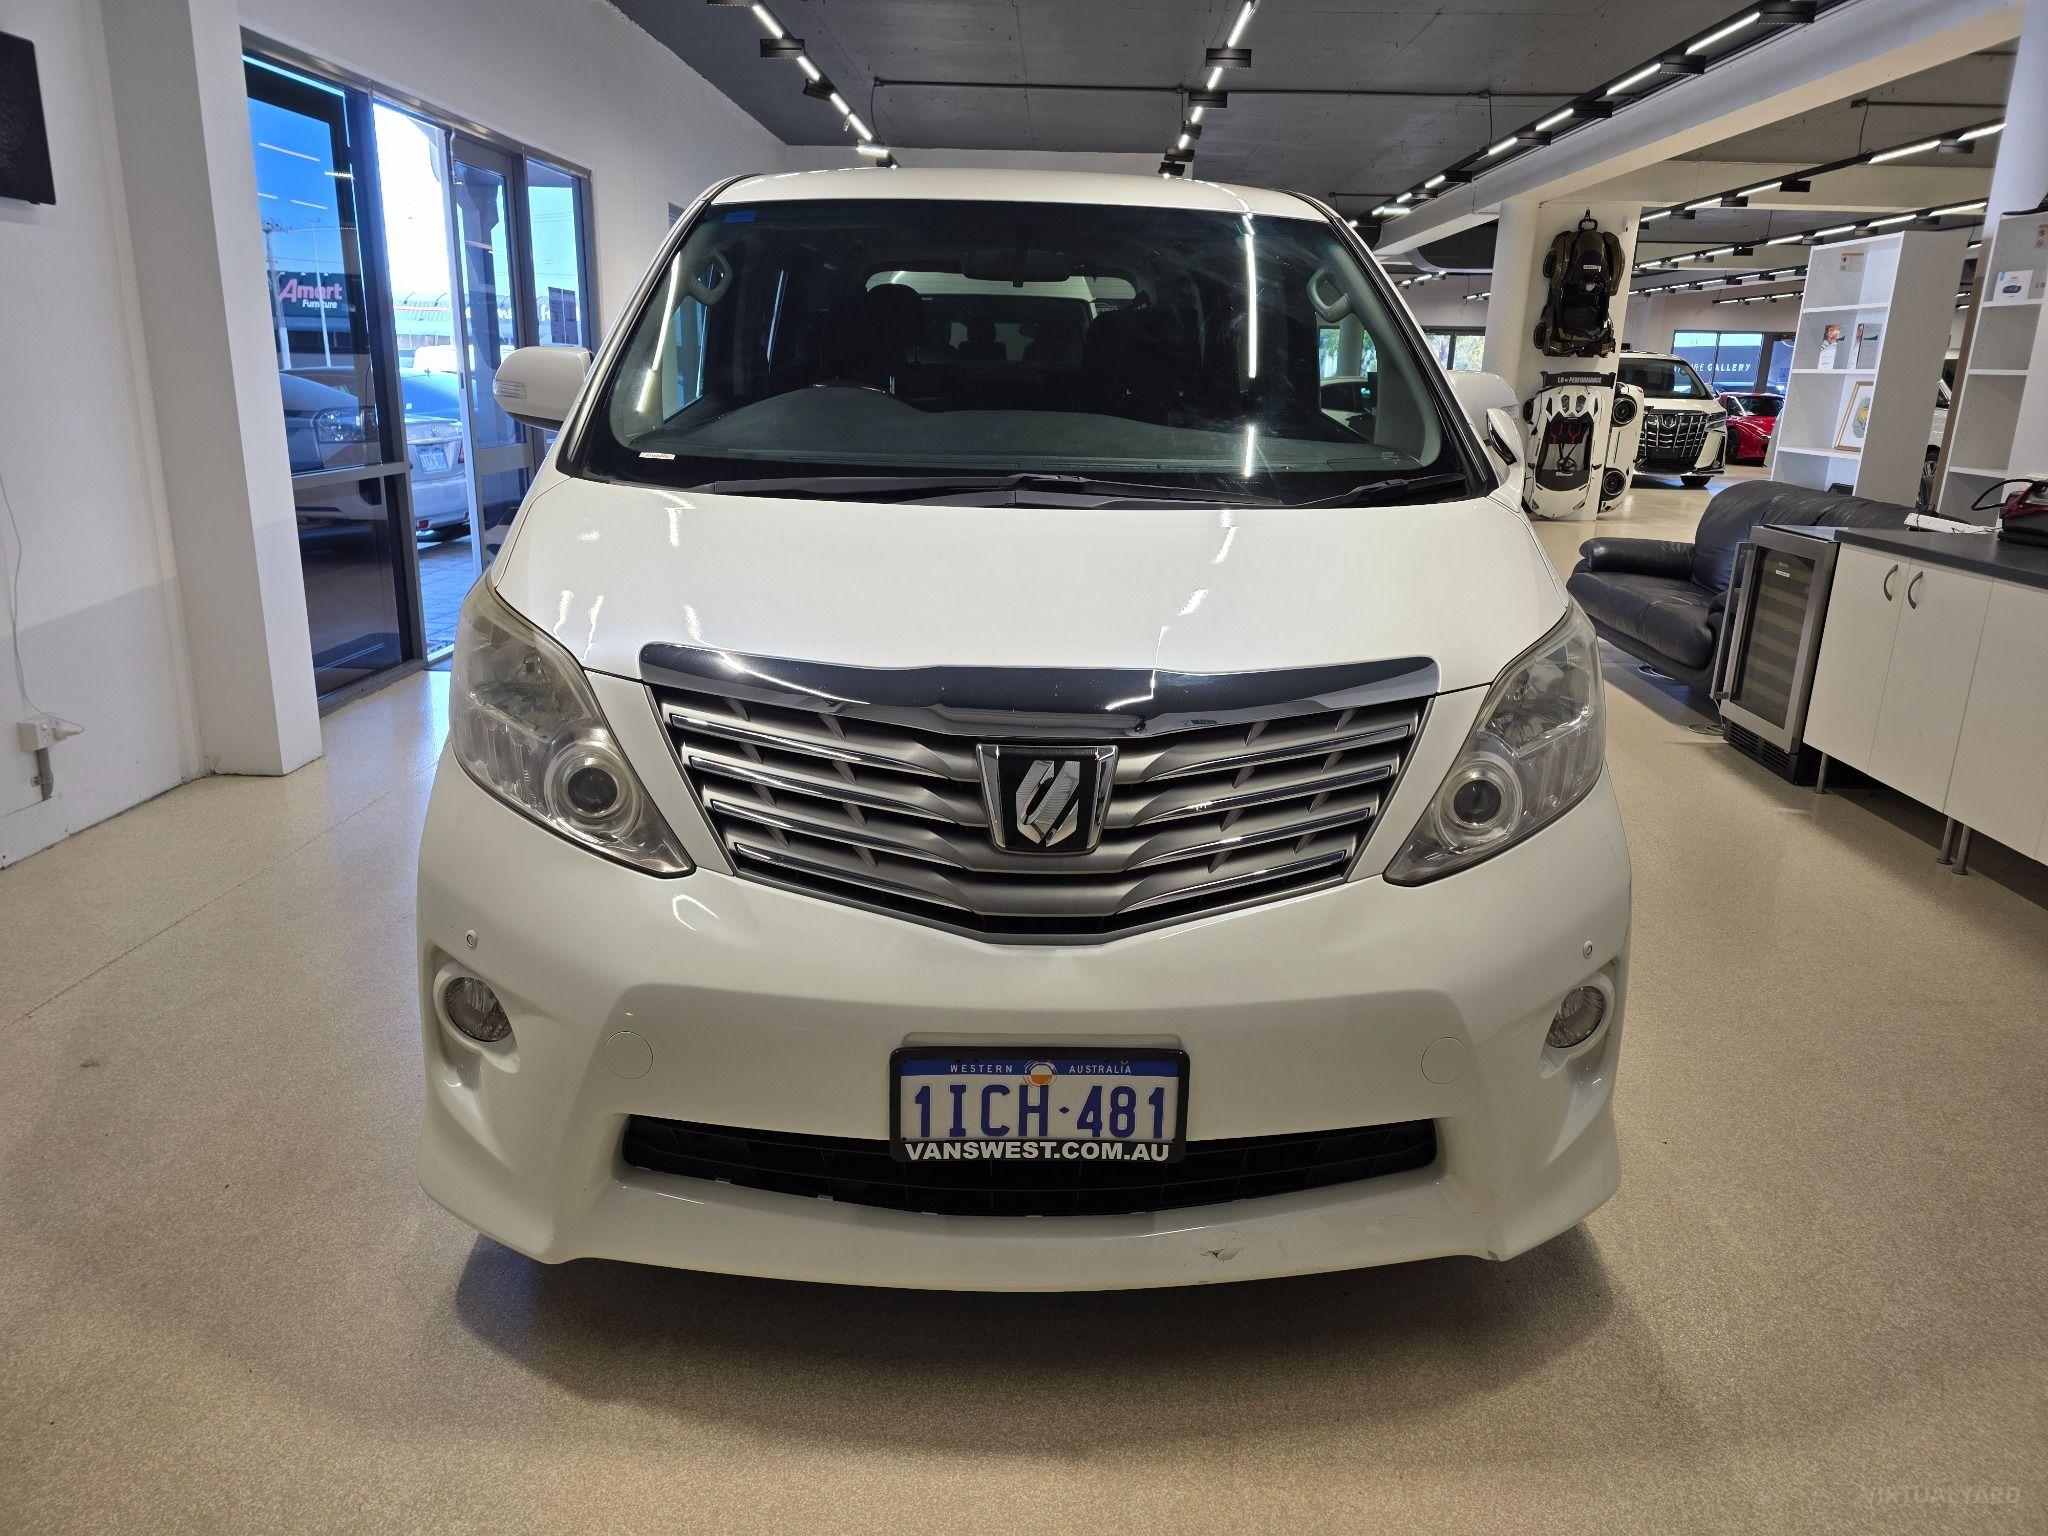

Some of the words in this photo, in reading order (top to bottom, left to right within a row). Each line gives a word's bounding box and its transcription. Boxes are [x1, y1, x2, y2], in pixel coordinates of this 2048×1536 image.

[279, 278, 343, 303] Amart
[302, 299, 338, 309] Furnure
[1707, 363, 1751, 372] GALLERY
[950, 1064, 1013, 1073] WESTERN
[1069, 1064, 1132, 1074] AUSTRALIA
[904, 1141, 1169, 1162] VANSWEST.COM.AU
